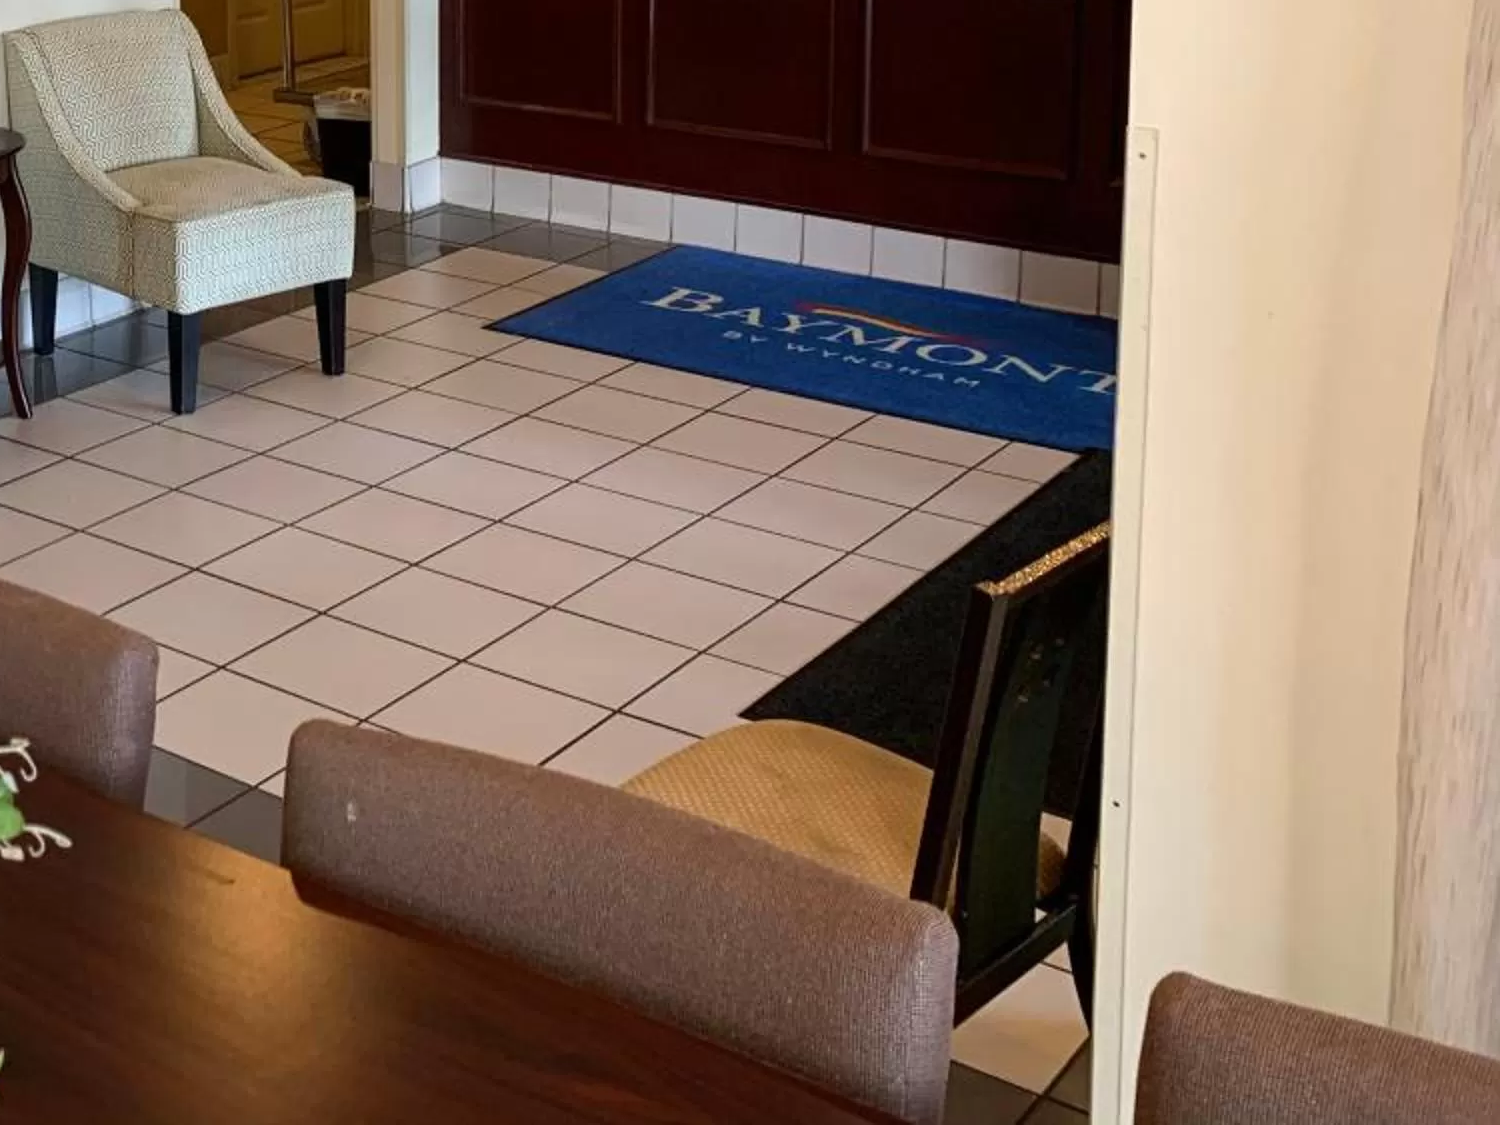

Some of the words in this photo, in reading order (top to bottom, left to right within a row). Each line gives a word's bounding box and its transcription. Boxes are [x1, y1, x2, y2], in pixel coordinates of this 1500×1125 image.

[639, 286, 1118, 395] BAYMONT
[722, 330, 768, 343] BY
[786, 342, 981, 388] WYNDHAM
